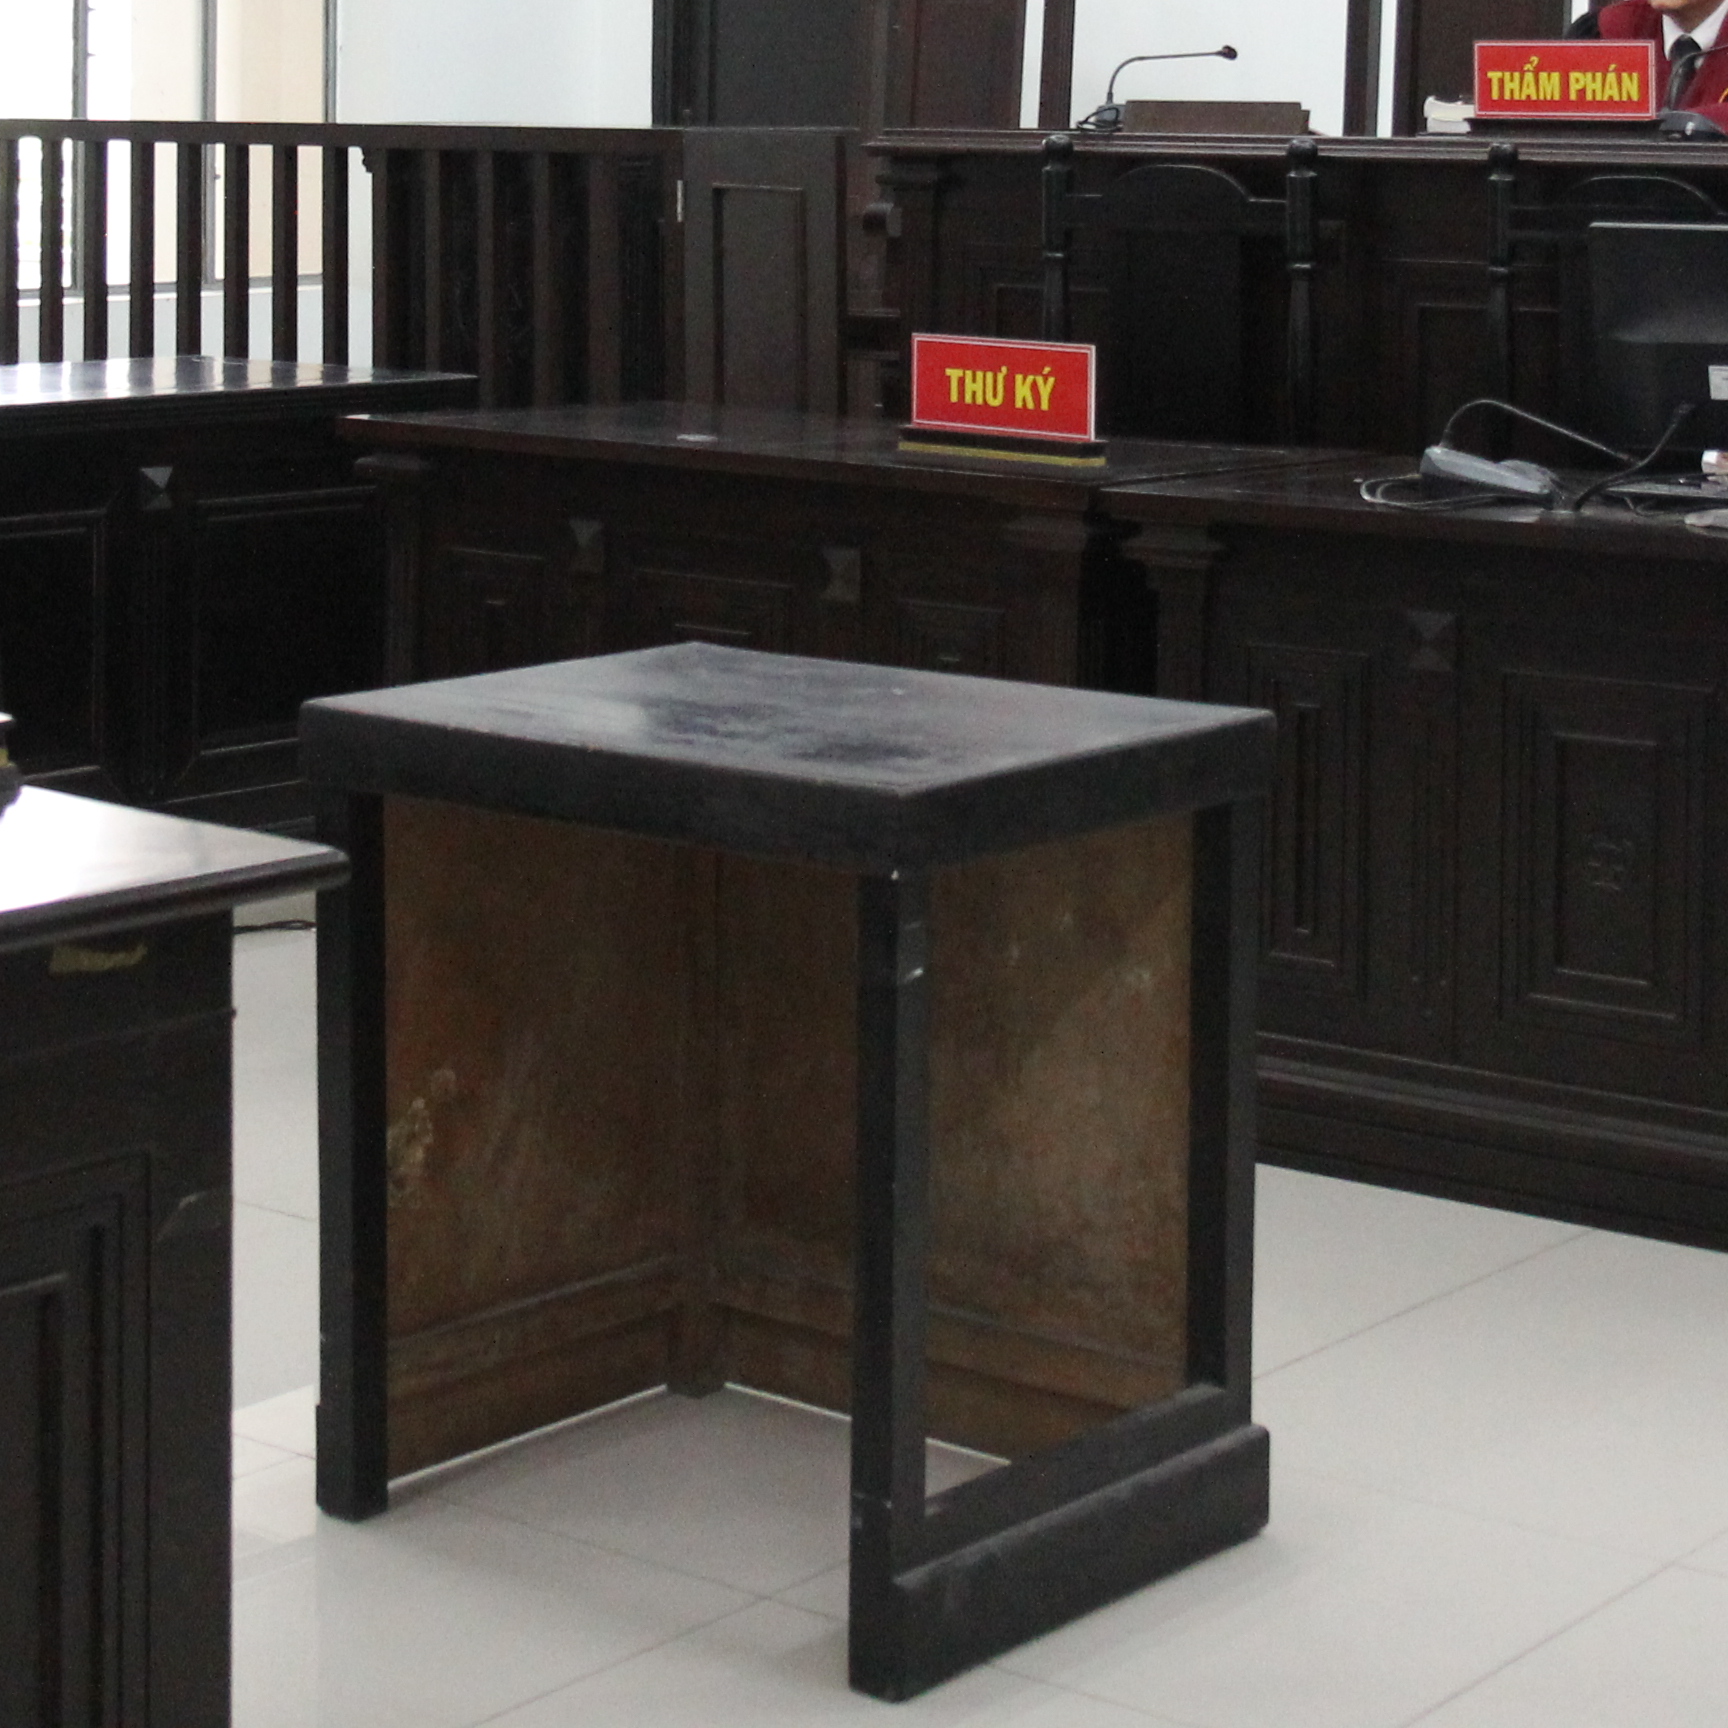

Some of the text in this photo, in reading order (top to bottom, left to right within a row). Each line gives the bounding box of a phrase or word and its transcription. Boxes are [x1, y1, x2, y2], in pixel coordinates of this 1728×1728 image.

[1487, 56, 1639, 101] THẨM PHÁN
[945, 366, 1056, 411] THƯ KÝ
